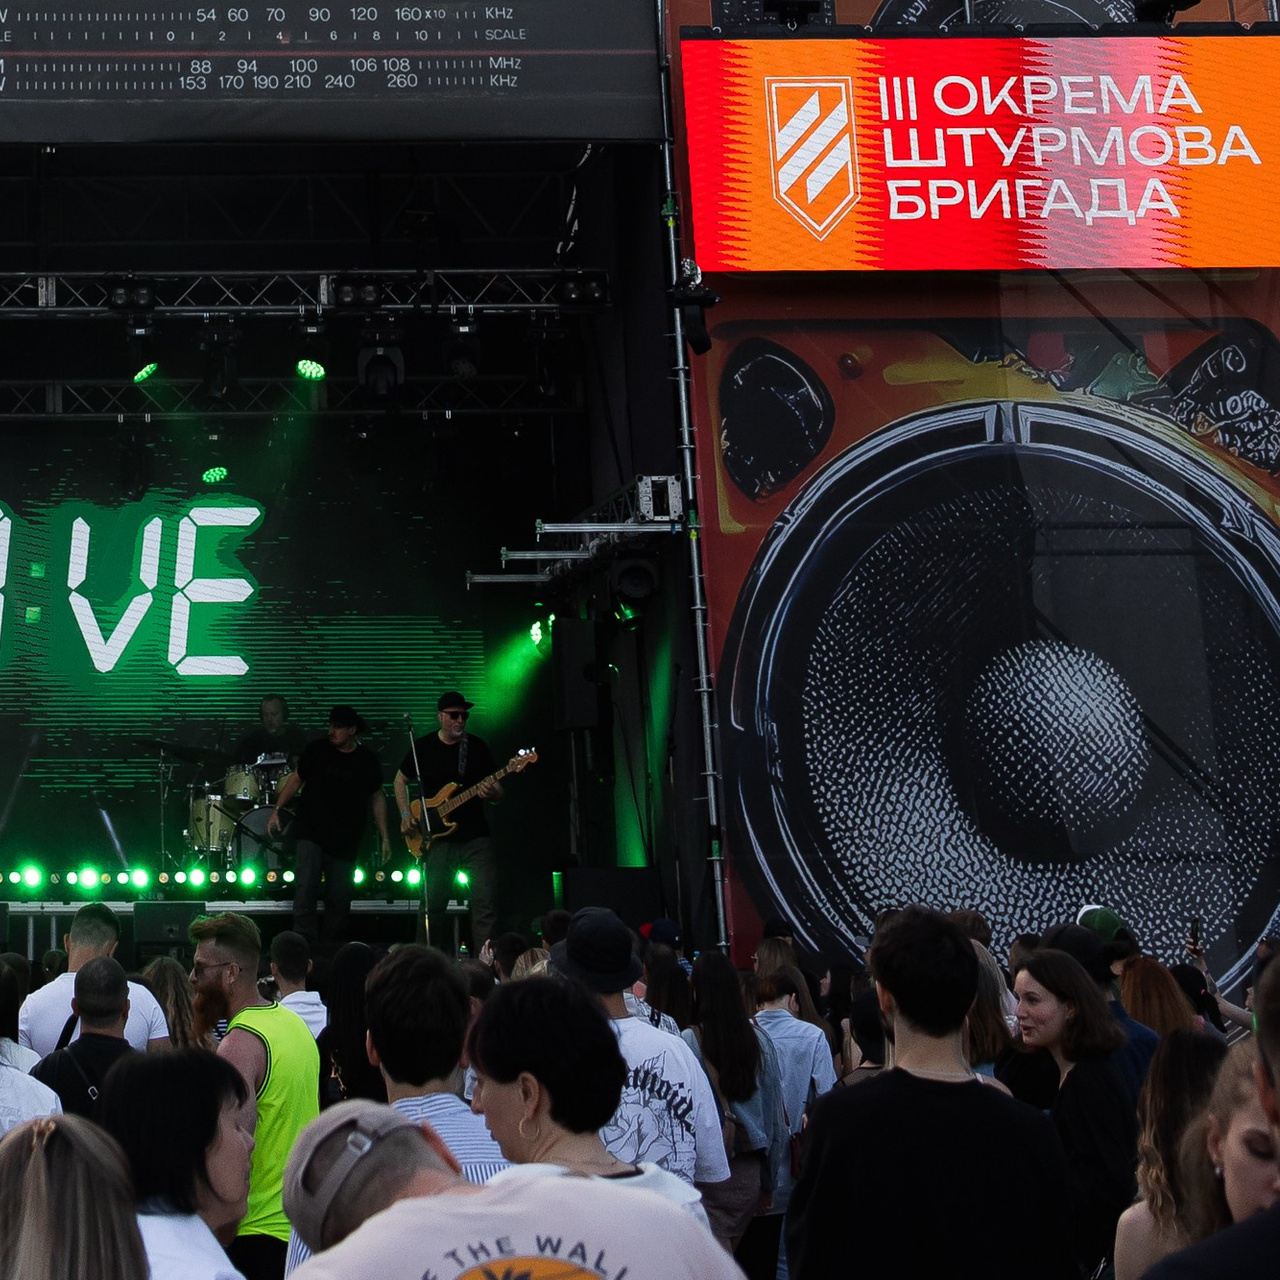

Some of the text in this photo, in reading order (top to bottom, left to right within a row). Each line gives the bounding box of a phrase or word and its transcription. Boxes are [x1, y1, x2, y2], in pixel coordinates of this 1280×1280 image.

[196, 7, 217, 23] 54
[227, 8, 249, 23] 60
[266, 7, 286, 22] 70
[308, 7, 331, 22] 90
[349, 6, 378, 21] 120
[166, 30, 175, 42] 0
[218, 30, 226, 42] 2
[276, 30, 284, 41] 4
[329, 30, 338, 41] 6
[372, 30, 381, 41] 8
[414, 29, 429, 42] 10
[485, 28, 527, 41] SCALE
[190, 59, 212, 75] 88
[236, 59, 258, 74] 94
[289, 58, 318, 73] 100
[350, 57, 378, 72] 106
[382, 57, 411, 72] 108
[179, 75, 207, 91] 153
[218, 75, 245, 90] 170
[252, 75, 279, 90] 190
[283, 74, 312, 89] 210
[324, 74, 356, 89] 240
[386, 73, 418, 88] 260
[933, 74, 1204, 116] ОКРЕМА
[882, 125, 1262, 168] ШТУРМОВА
[886, 177, 1182, 226] БРИГАДА
[443, 1234, 628, 1280] THE WAL
